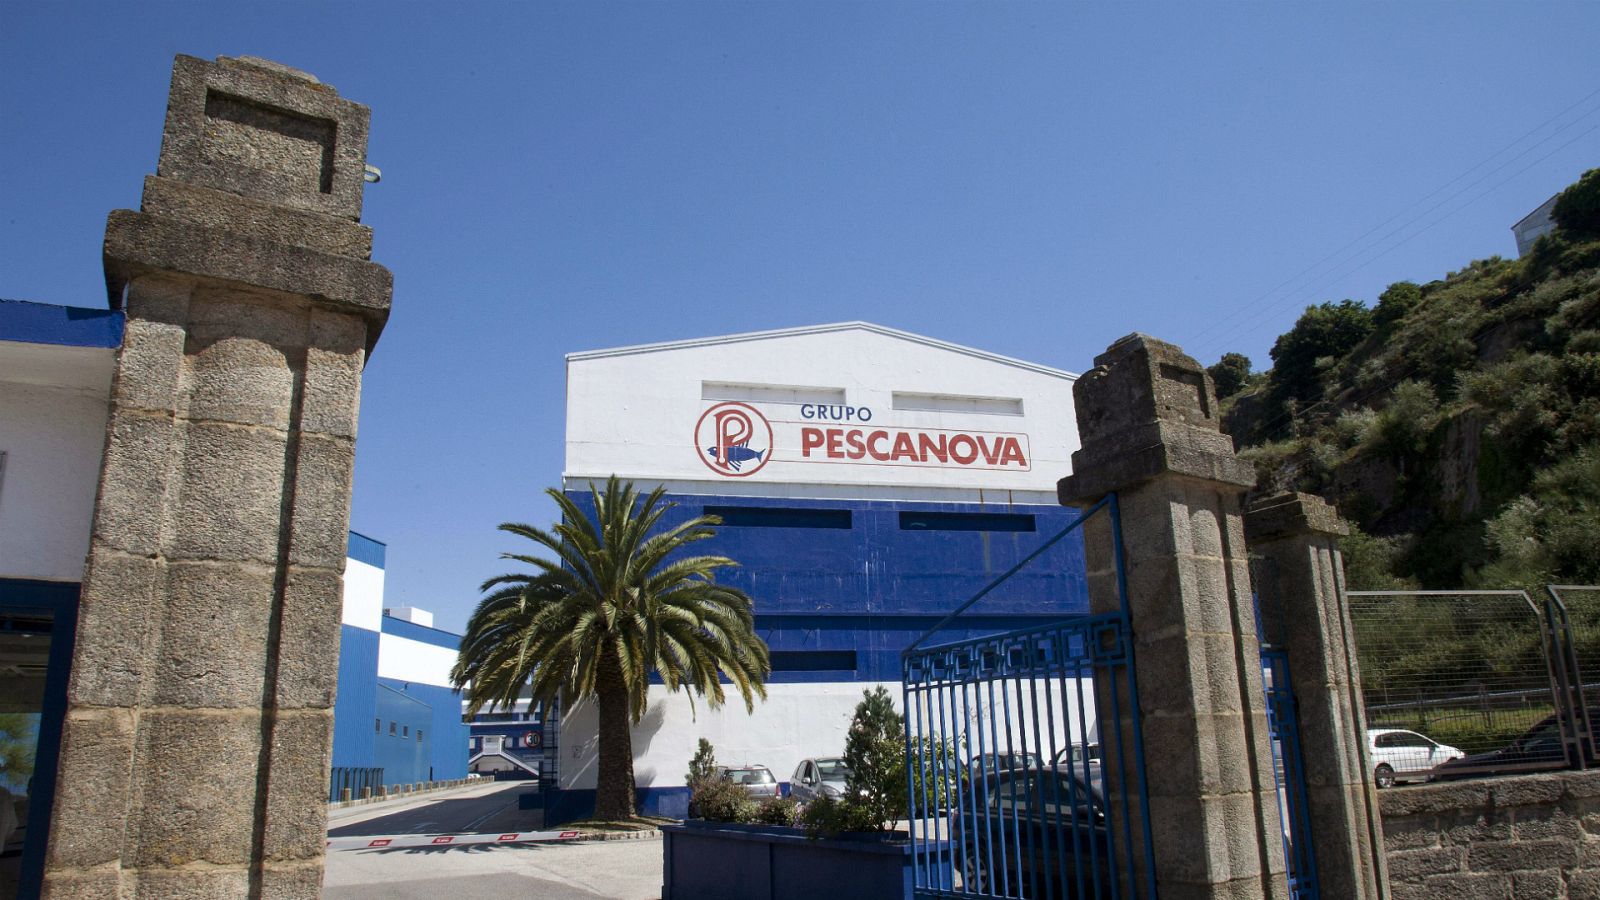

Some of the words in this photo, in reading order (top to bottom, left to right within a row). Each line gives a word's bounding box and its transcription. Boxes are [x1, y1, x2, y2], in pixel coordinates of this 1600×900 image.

[801, 404, 872, 422] GRUPO
[802, 428, 1027, 466] PESCANOVA
[527, 734, 538, 745] 30
